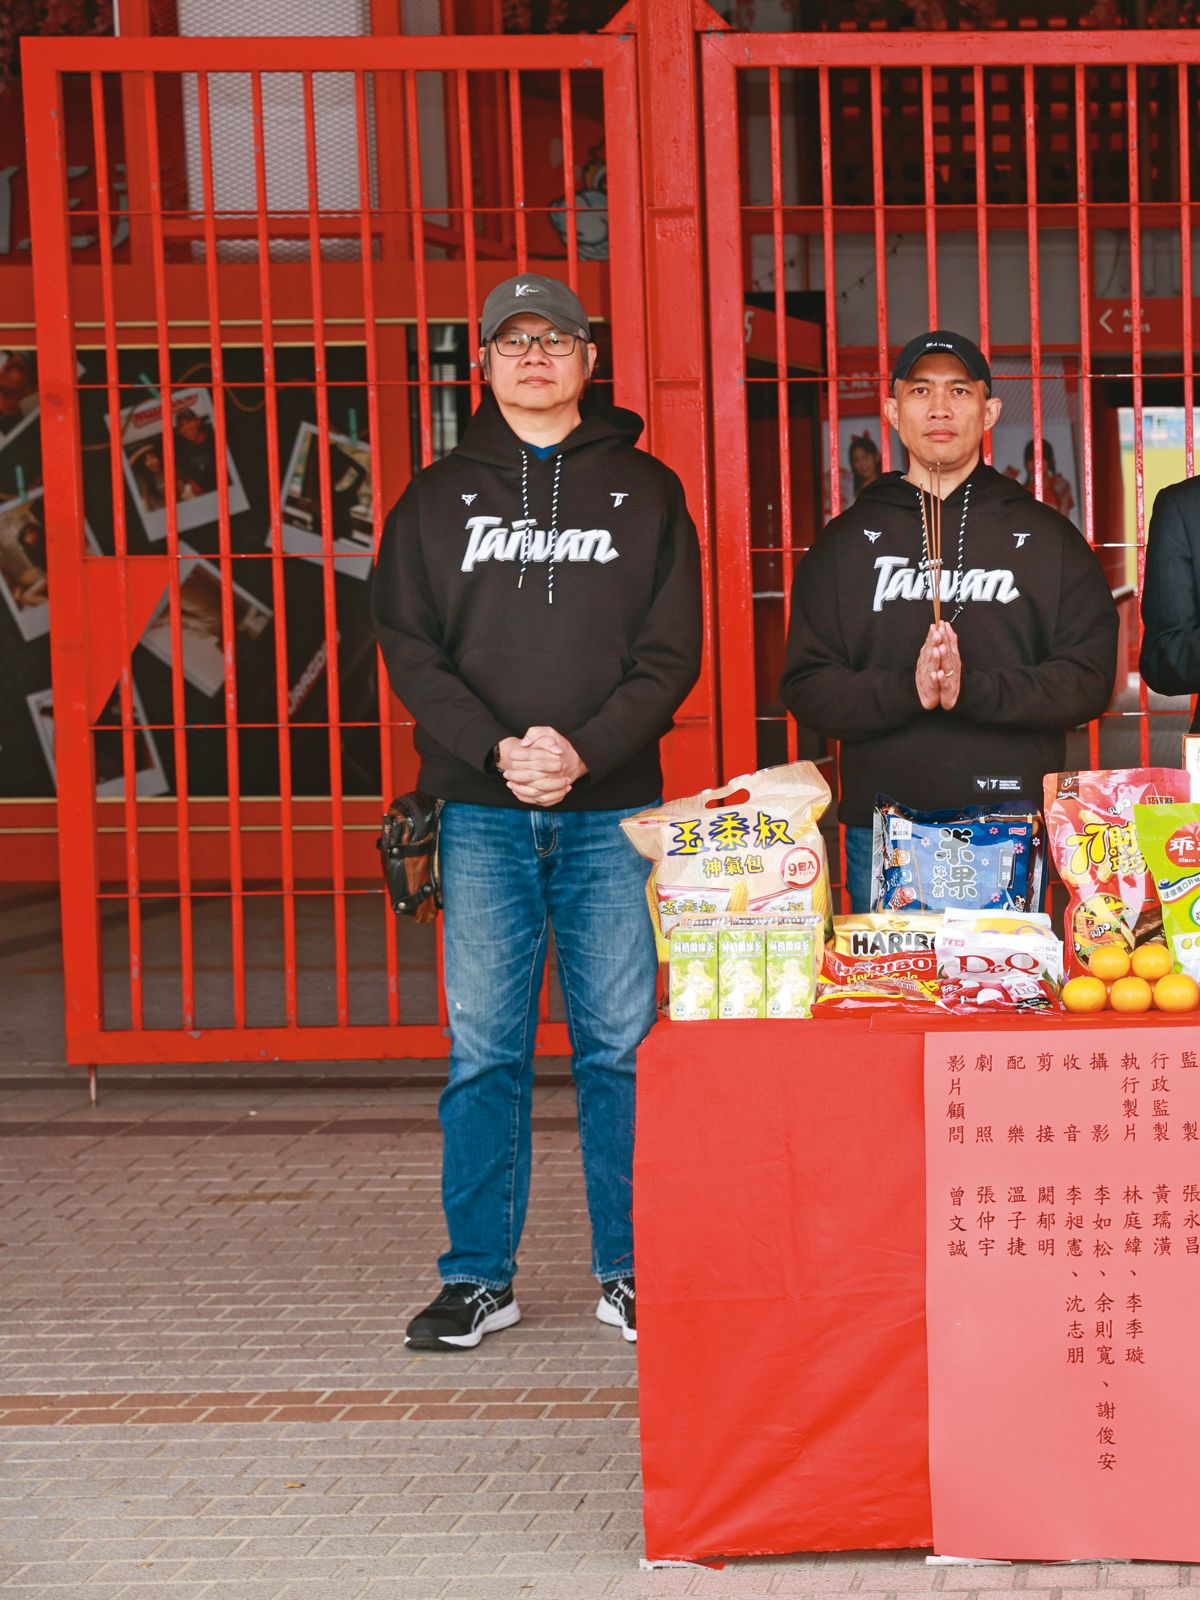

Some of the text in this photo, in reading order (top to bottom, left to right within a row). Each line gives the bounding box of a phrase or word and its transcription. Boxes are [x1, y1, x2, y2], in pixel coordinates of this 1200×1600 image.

[460, 515, 620, 573] Taiwan
[872, 555, 1021, 613] Taiwan
[703, 855, 765, 878] 神氣包
[934, 827, 978, 900] 米果
[1063, 1054, 1082, 1143] 收音
[1090, 1053, 1110, 1143] 攝影
[1121, 1053, 1141, 1142] 執行製片
[1150, 1052, 1171, 1142] 行政監製
[1181, 1052, 1199, 1142] 監製
[947, 1056, 968, 1258] 影片顧問 曾文誠
[975, 1053, 996, 1257] 劇照 張仲宇
[1007, 1055, 1027, 1257] 配樂 溫子捷
[1036, 1053, 1056, 1256] 剪接 闕郁明
